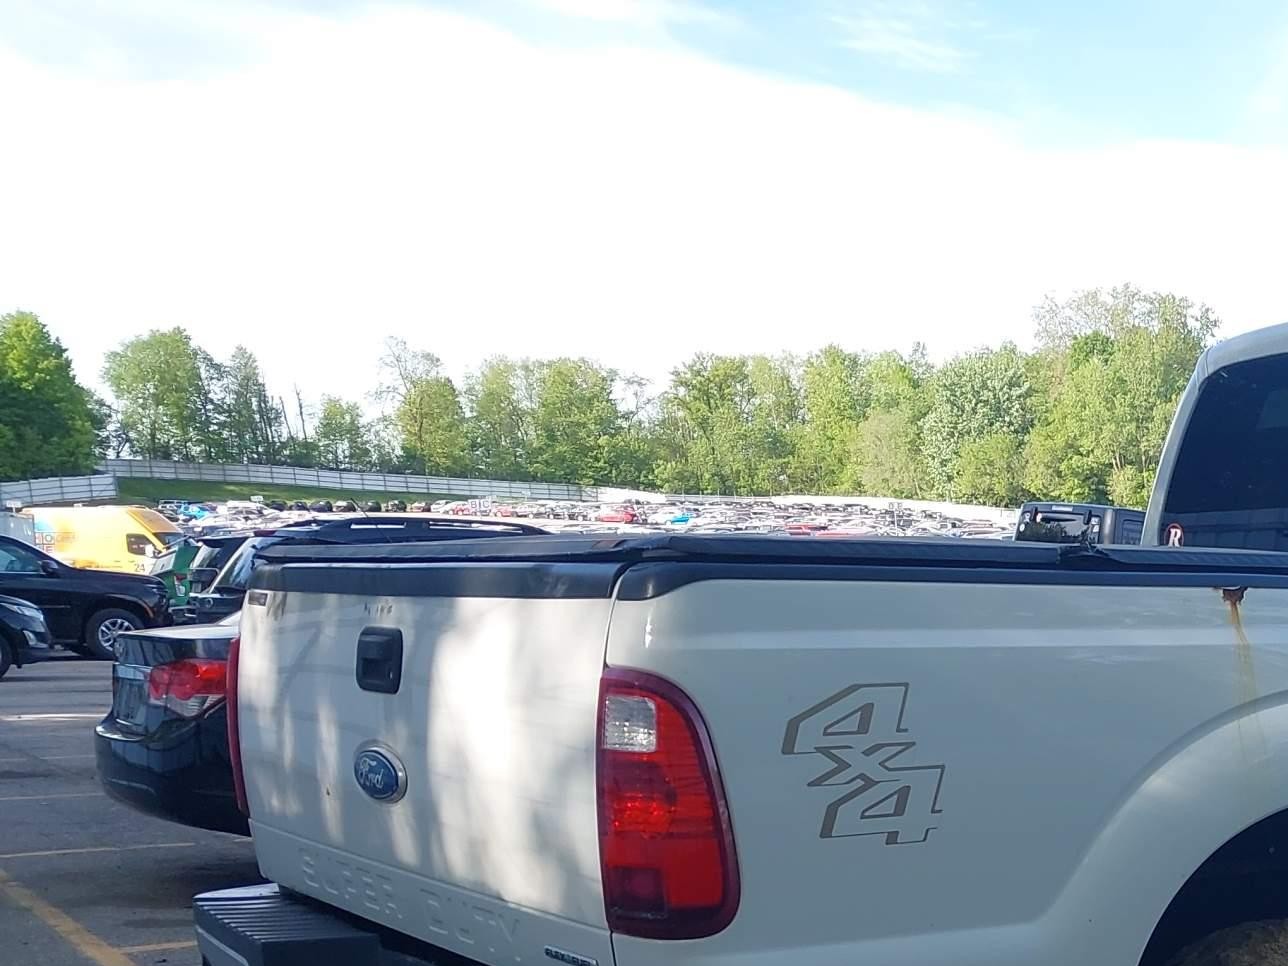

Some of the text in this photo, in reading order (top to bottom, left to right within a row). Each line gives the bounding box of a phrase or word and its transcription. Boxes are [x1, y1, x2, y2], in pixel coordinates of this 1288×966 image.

[1167, 528, 1182, 548] R
[358, 757, 385, 789] Ford
[297, 847, 522, 963] SUPER DUTY
